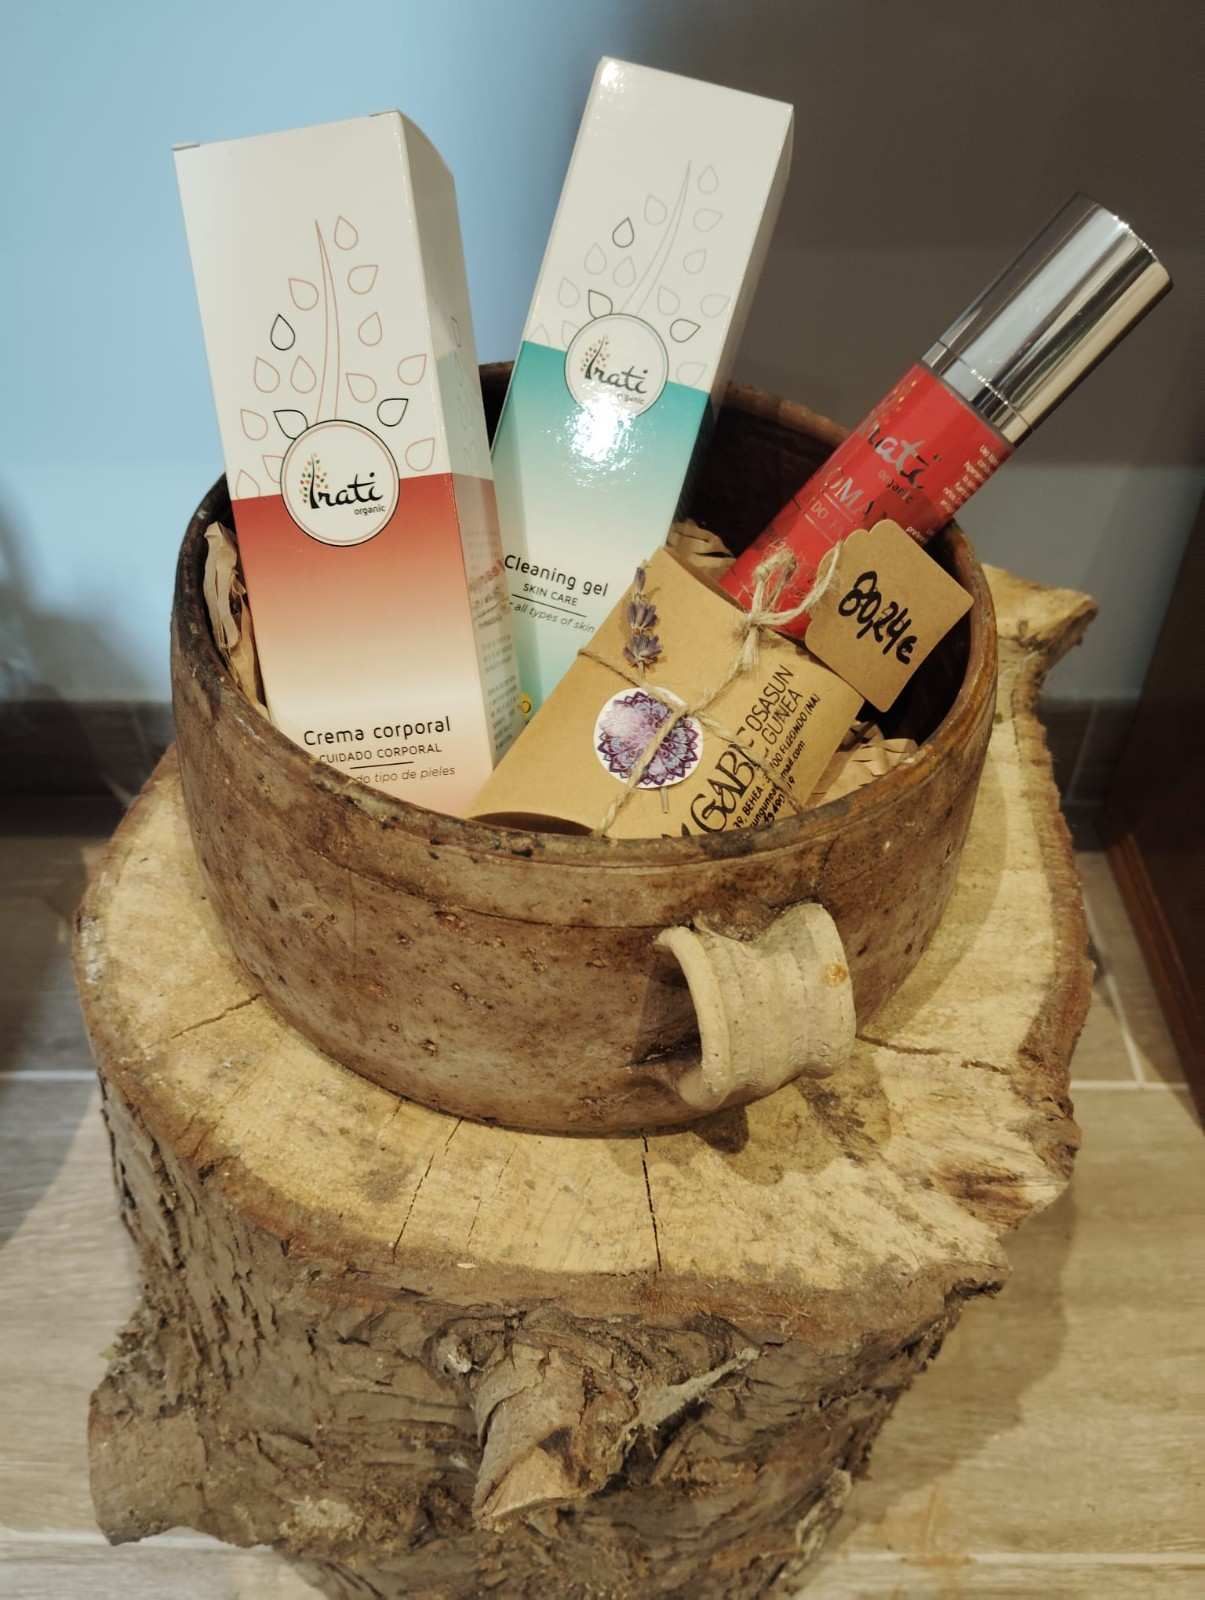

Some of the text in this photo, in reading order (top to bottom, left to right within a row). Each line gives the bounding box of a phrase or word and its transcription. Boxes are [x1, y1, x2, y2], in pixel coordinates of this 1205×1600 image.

[309, 454, 384, 509] Irati
[354, 504, 385, 516] organic
[504, 554, 609, 597] Cleaning gel
[514, 602, 528, 613] all
[523, 583, 579, 606] SKIN CARE
[745, 664, 794, 733] OSASUN
[303, 715, 451, 747] Crema corporal
[761, 689, 803, 745] GUNEA
[376, 743, 443, 759] CORPORAL
[374, 771, 398, 785] tipo
[402, 769, 417, 781] de
[420, 766, 456, 780] pieles
[742, 785, 764, 816] BEHEA
